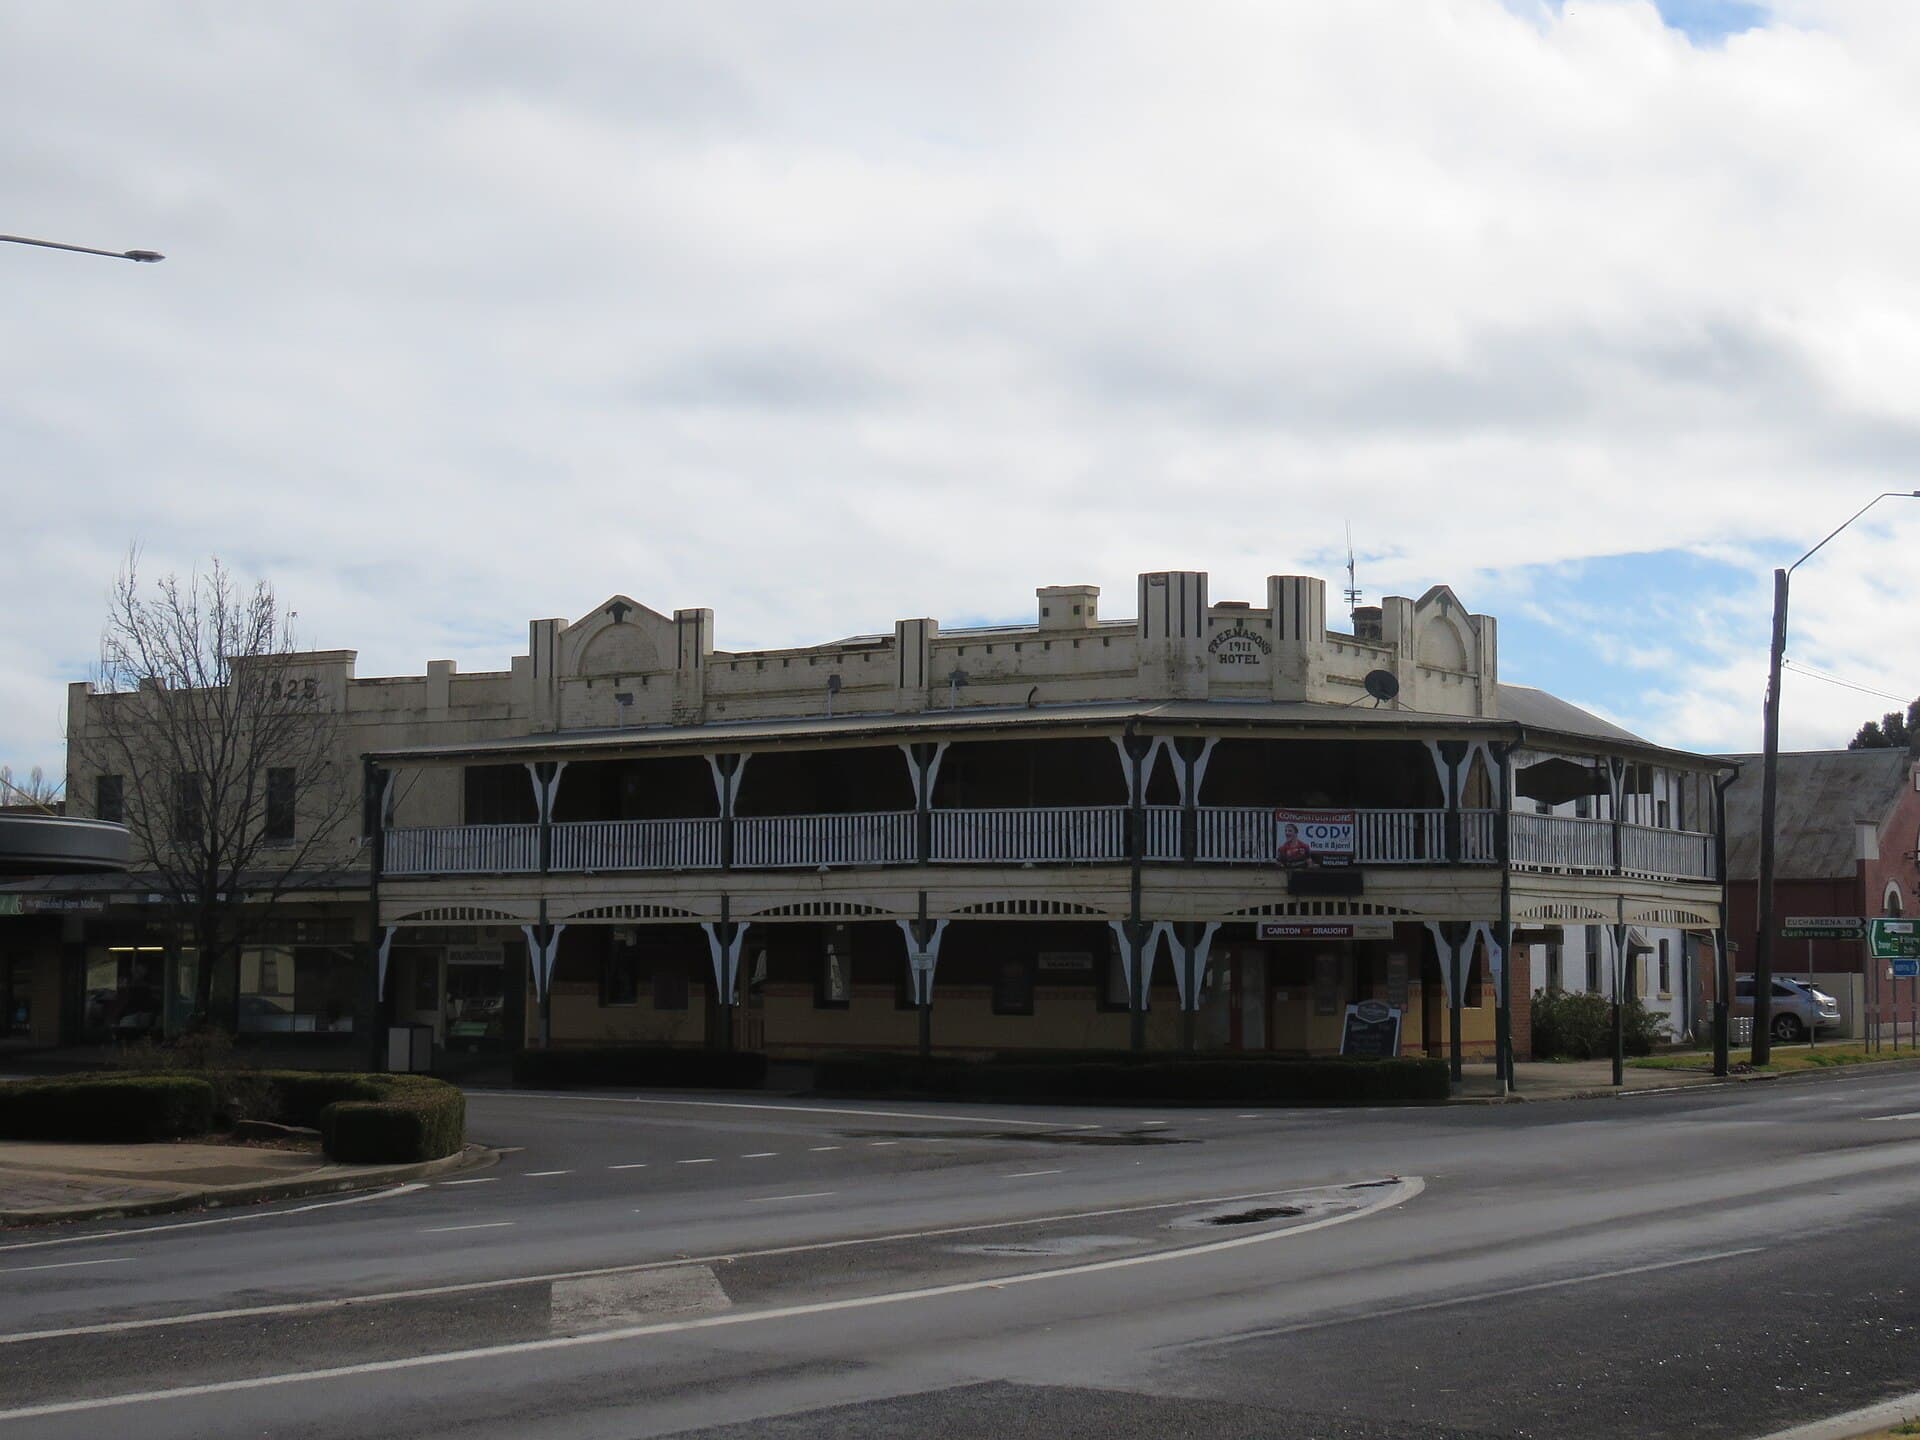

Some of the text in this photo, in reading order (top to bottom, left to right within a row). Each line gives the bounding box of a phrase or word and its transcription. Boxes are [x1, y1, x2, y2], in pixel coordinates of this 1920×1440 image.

[1230, 642, 1251, 651] 1911
[1219, 654, 1260, 664] HOTEL
[1305, 826, 1351, 839] CODY
[1267, 927, 1301, 935] CARLTON
[1312, 927, 1348, 935] DRAUGHT
[1781, 928, 1836, 937] Euchareena
